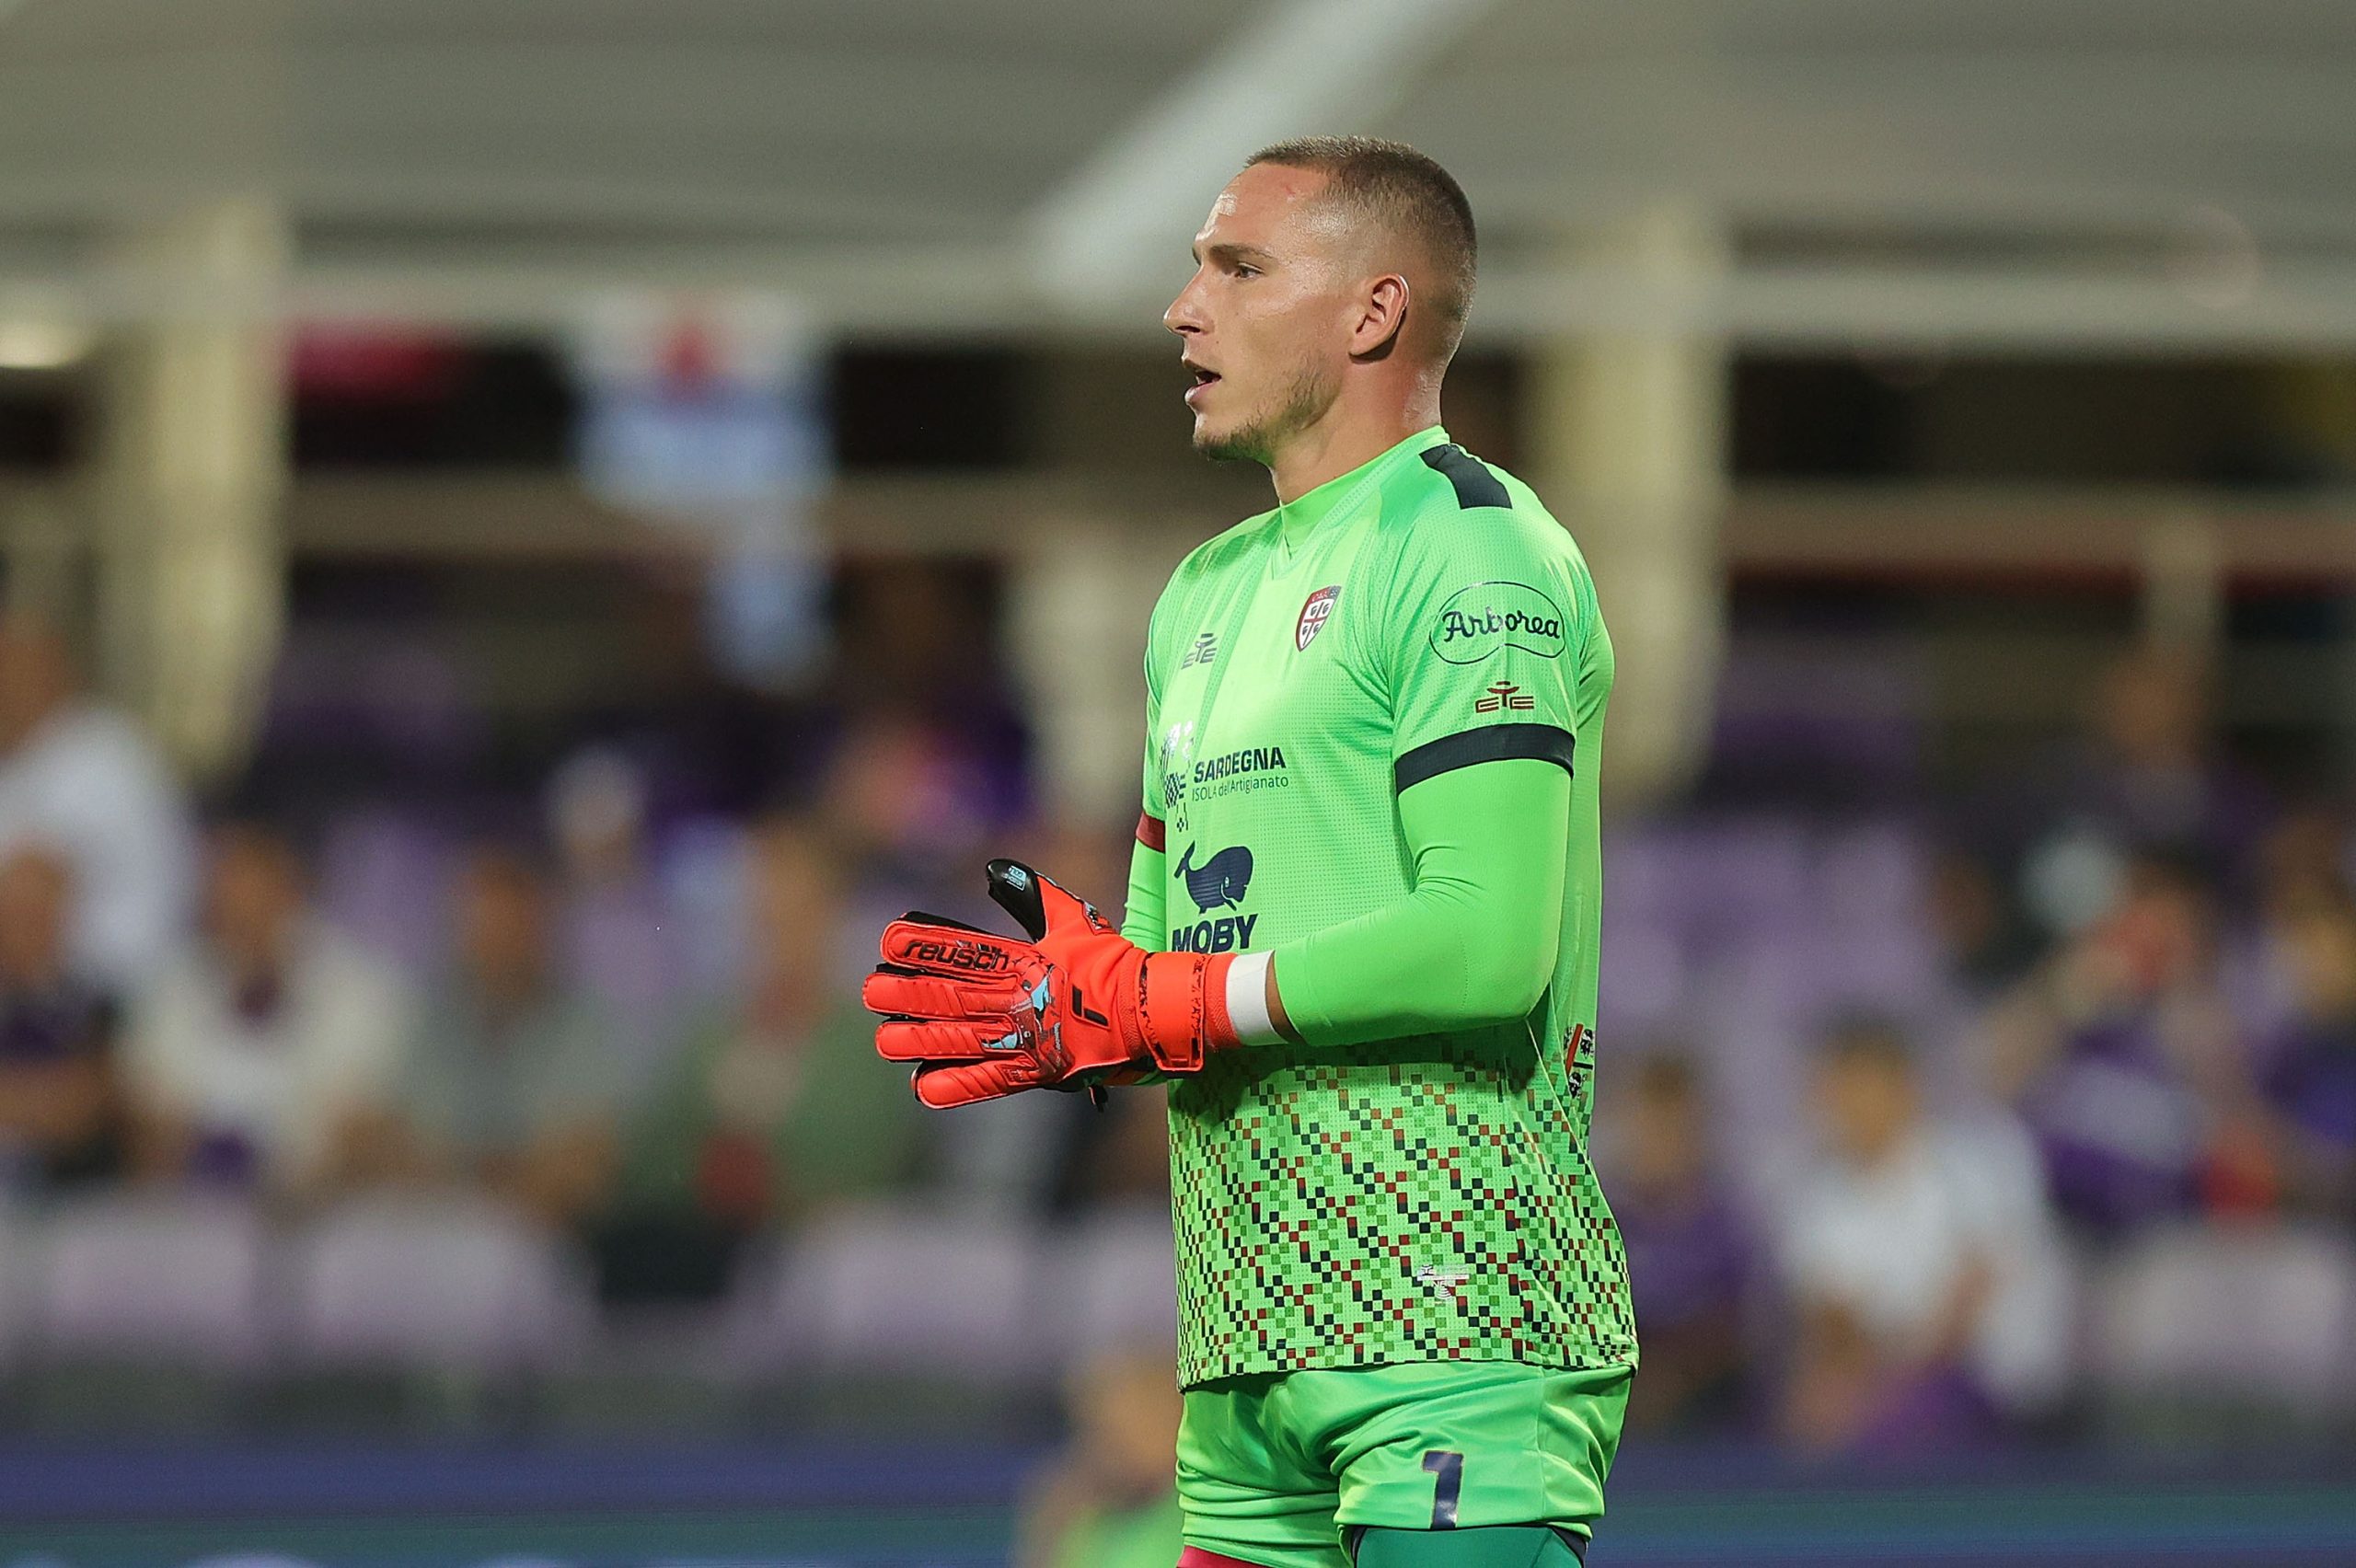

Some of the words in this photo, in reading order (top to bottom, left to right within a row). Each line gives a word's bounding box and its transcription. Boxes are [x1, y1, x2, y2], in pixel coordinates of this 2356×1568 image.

[1442, 606, 1560, 642] Arborea
[1194, 747, 1286, 783] SARDEGNA
[1192, 784, 1218, 801] ISOLA
[1172, 914, 1258, 954] MOBY
[904, 941, 1009, 970] reusch
[1422, 1450, 1463, 1531] 1
